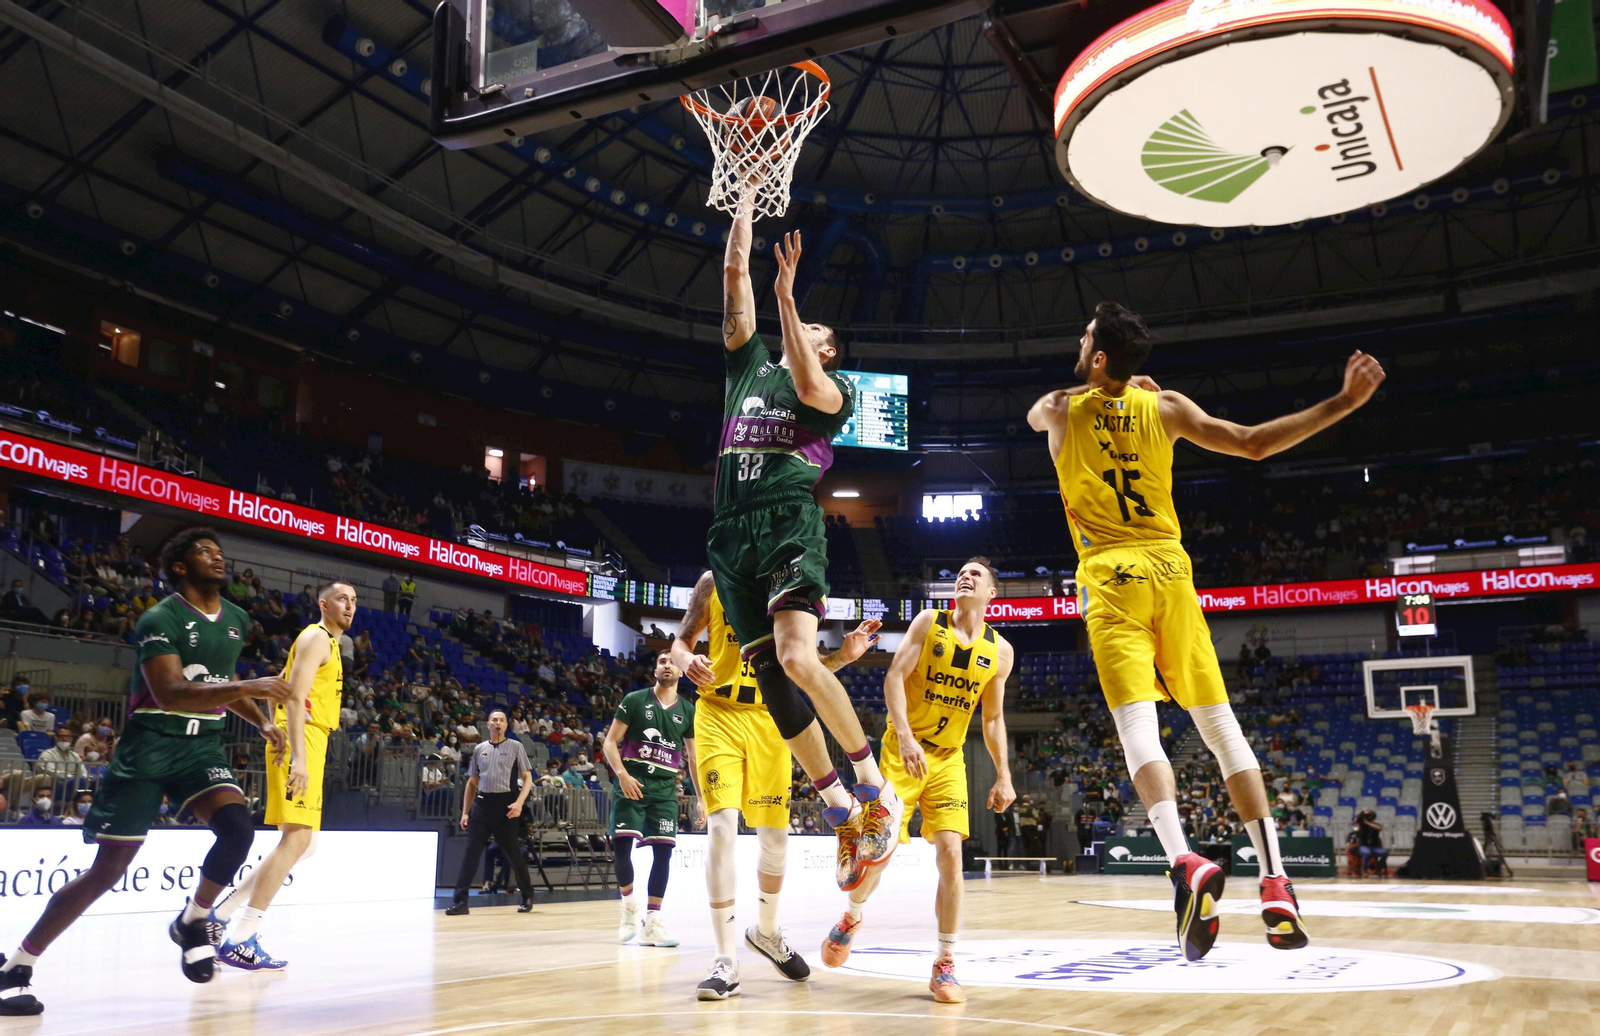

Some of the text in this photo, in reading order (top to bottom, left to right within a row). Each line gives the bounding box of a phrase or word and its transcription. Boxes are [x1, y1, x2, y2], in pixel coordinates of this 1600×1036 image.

[1300, 78, 1377, 182] Unicaja
[761, 408, 796, 420] Unicaja
[1094, 413, 1137, 433] SASTRE
[738, 453, 764, 481] 32
[1103, 468, 1155, 522] 15
[1402, 607, 1430, 625] 10
[934, 716, 948, 735] 9
